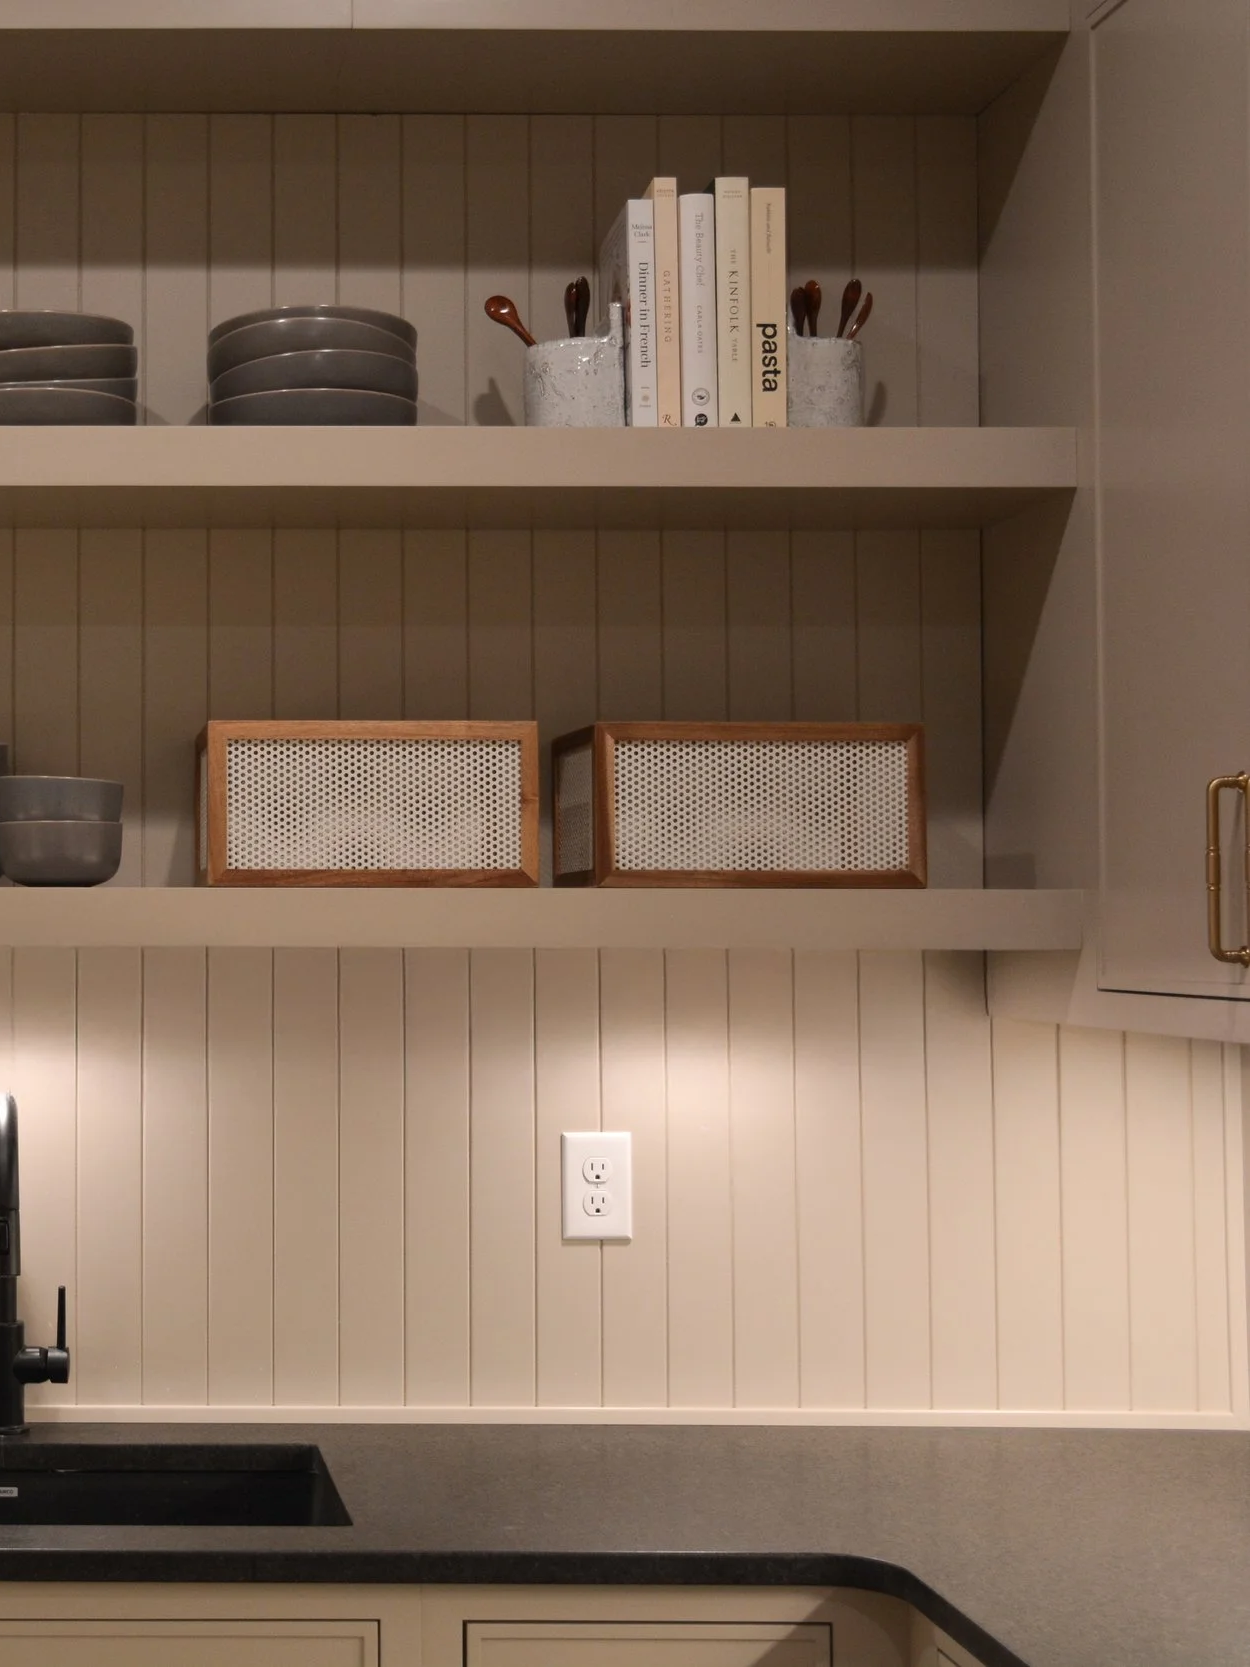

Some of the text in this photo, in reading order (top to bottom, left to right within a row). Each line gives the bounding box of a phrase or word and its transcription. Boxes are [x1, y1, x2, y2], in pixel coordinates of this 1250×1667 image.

[694, 213, 705, 287] The Beauty Chef
[638, 262, 652, 368] Dinner in French
[662, 270, 672, 343] GATHERING
[729, 271, 740, 333] KINFOLK
[731, 338, 739, 362] TABLE
[756, 323, 781, 393] pasta
